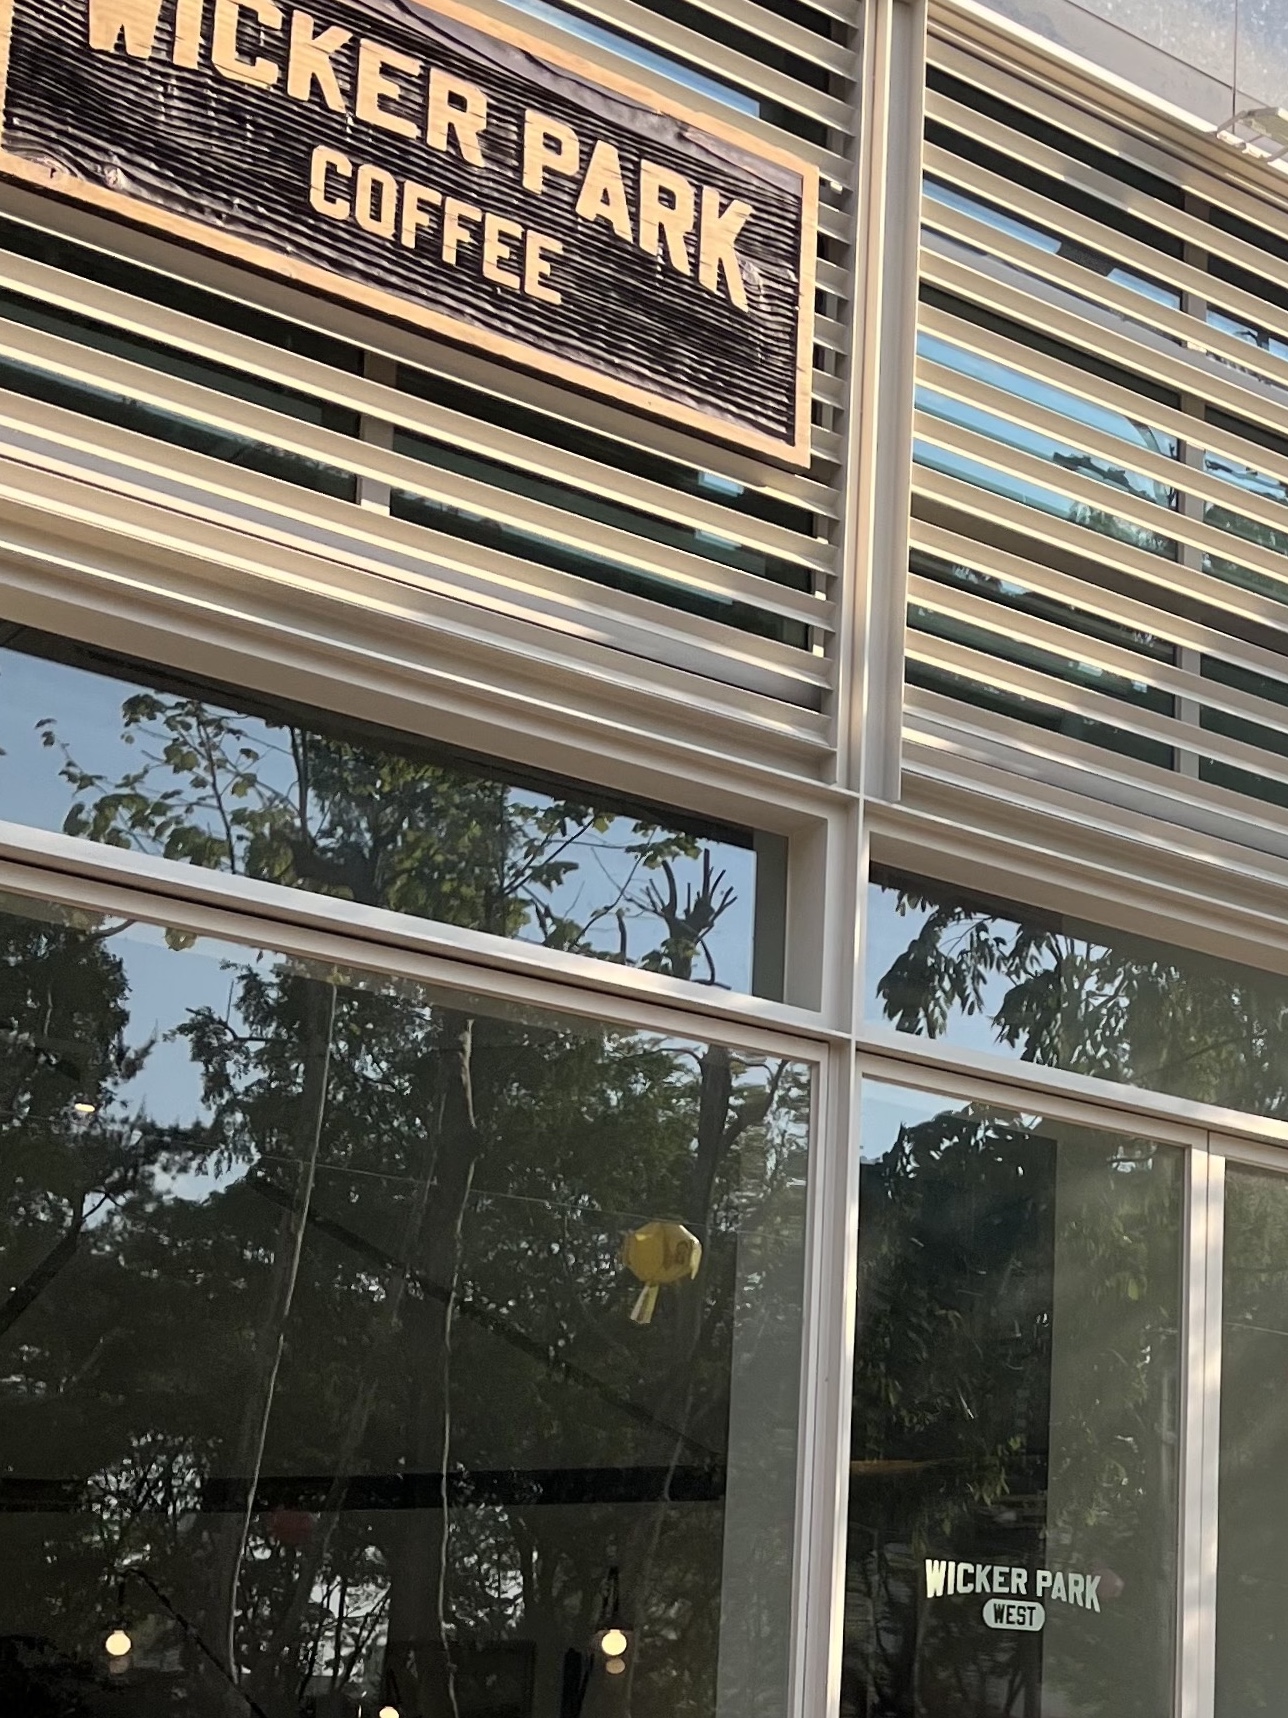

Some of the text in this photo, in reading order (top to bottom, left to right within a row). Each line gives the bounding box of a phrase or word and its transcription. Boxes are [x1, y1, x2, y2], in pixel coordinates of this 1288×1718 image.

[309, 145, 565, 307] COFFEE
[522, 109, 753, 313] PARK
[925, 1558, 1101, 1613] WICKER PARK
[993, 1602, 1037, 1627] WEST
